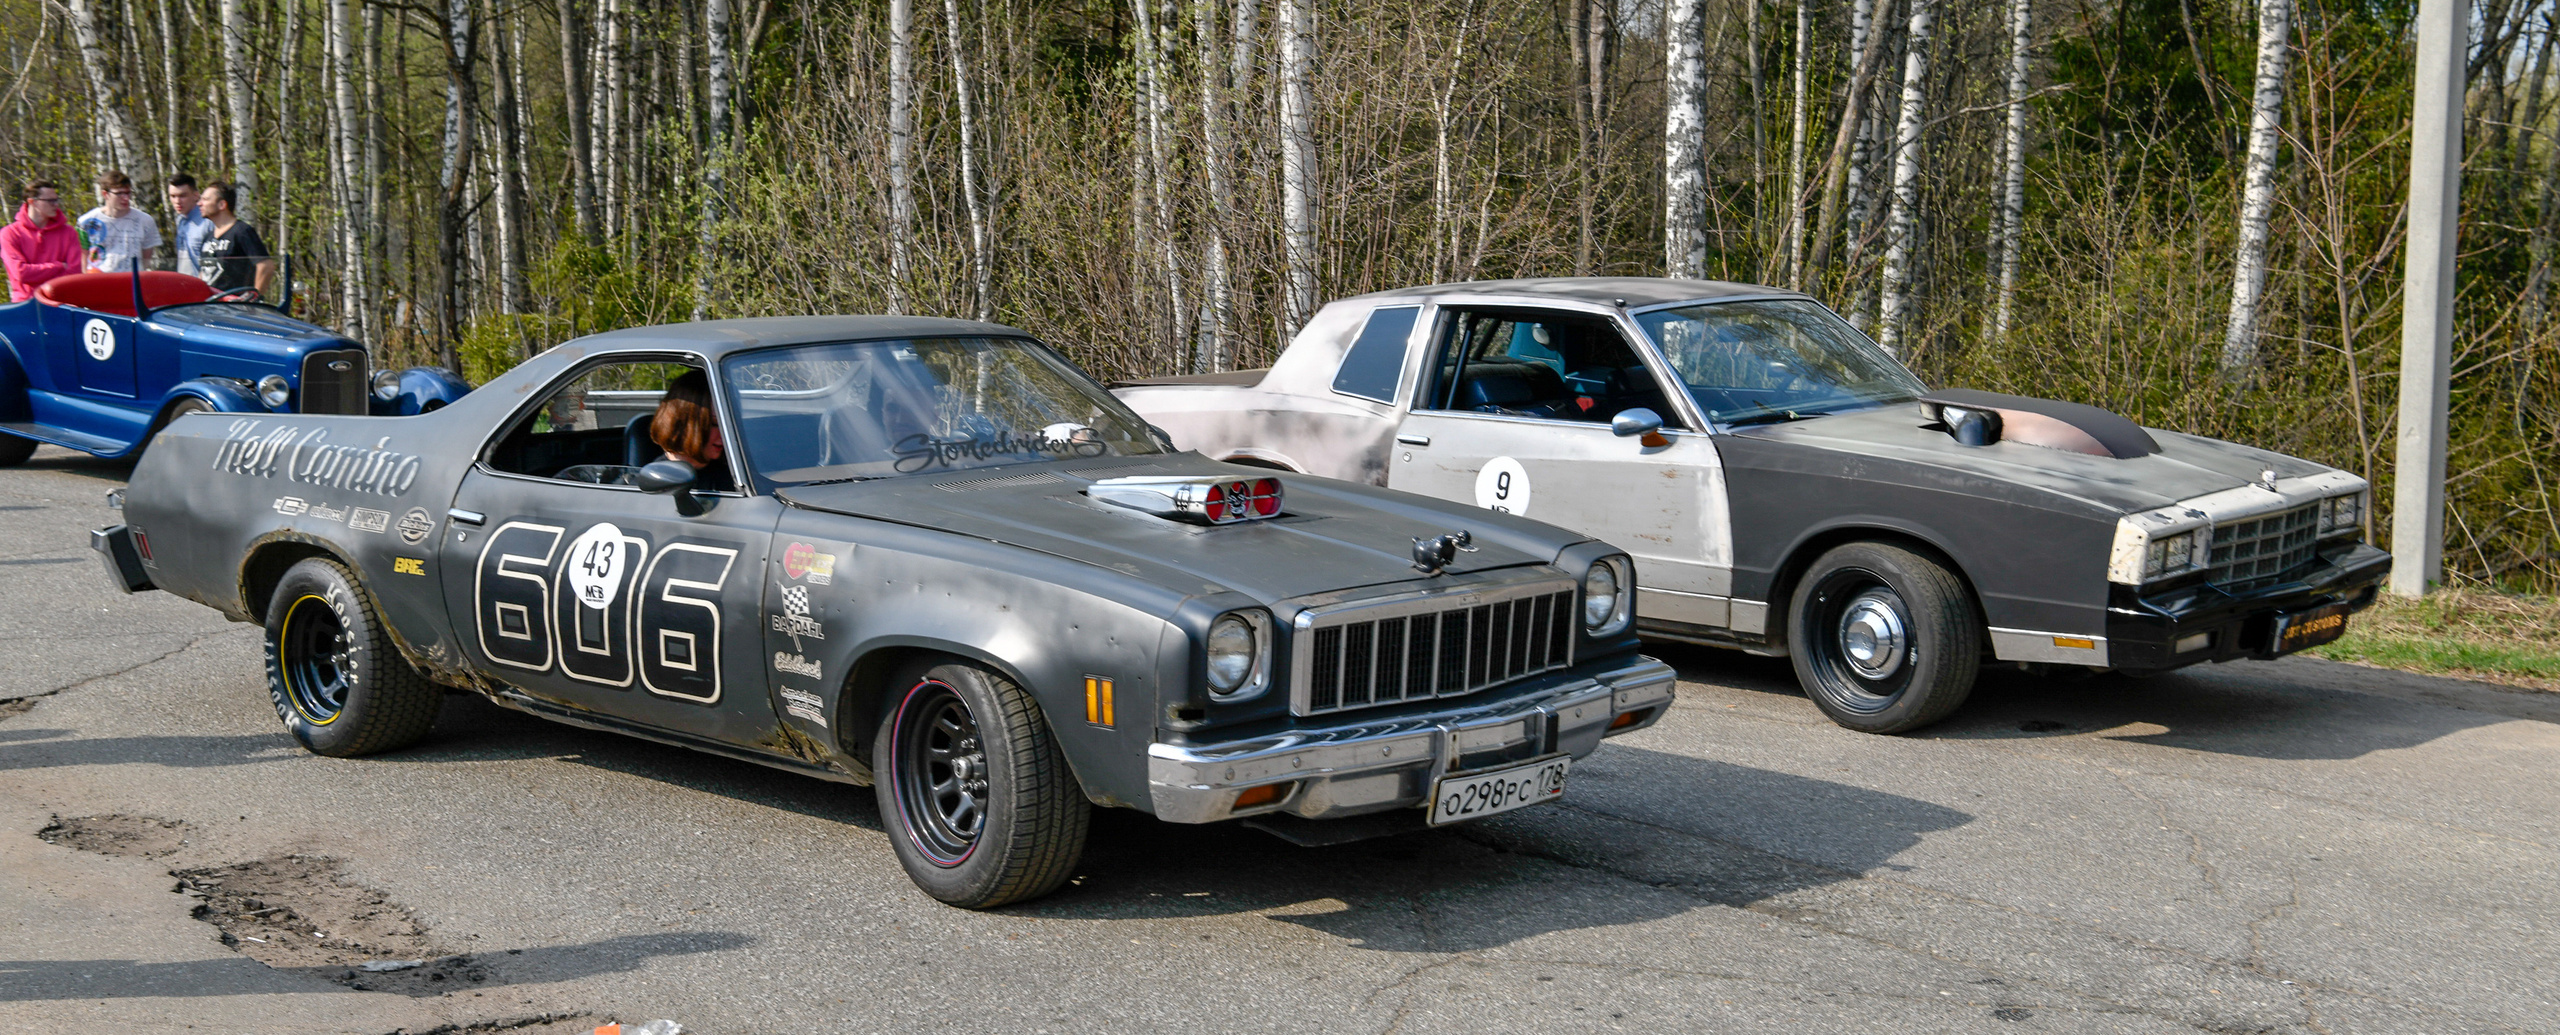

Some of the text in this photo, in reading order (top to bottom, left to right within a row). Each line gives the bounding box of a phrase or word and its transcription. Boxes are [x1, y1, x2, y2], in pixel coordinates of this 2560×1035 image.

[90, 326, 107, 346] 67
[212, 418, 298, 479] Hell
[1496, 471, 1511, 500] 9
[582, 540, 615, 578] 43
[475, 521, 739, 705] 606
[1537, 762, 1564, 790] 178
